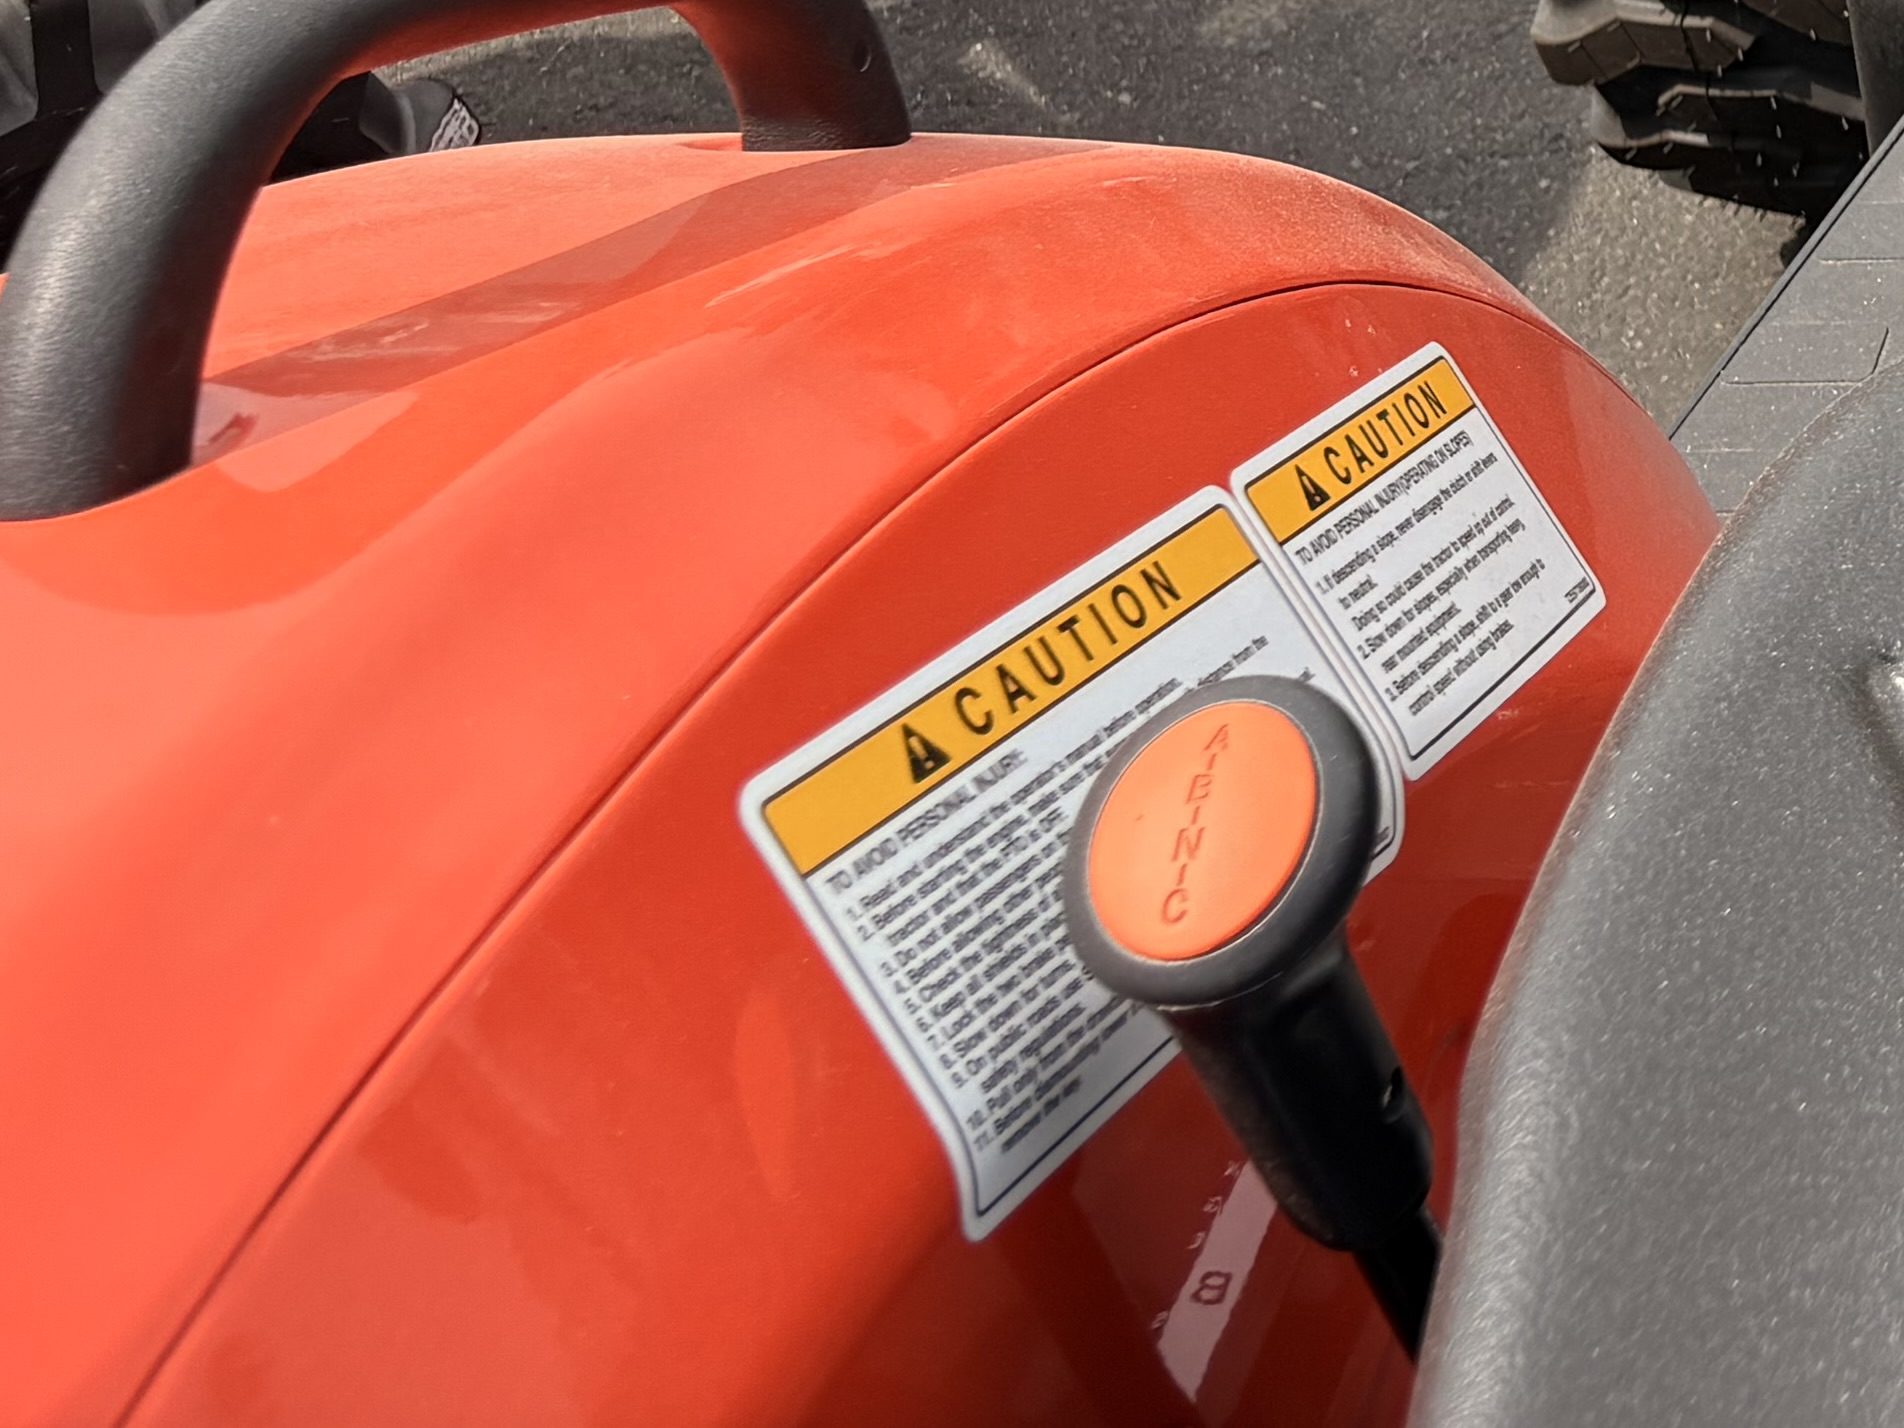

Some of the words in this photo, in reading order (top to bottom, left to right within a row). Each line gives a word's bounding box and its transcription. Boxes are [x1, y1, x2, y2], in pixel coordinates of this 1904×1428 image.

[1319, 378, 1448, 489] CAUTION
[1294, 545, 1314, 568] TO
[1309, 526, 1340, 557] AVOID
[1333, 497, 1380, 539] PERSONAL
[949, 555, 1184, 742] CAUTION
[825, 867, 854, 898] TO
[851, 835, 900, 881] AVOID
[895, 781, 977, 849] PERSONAL
[971, 745, 1028, 795] INJURY:
